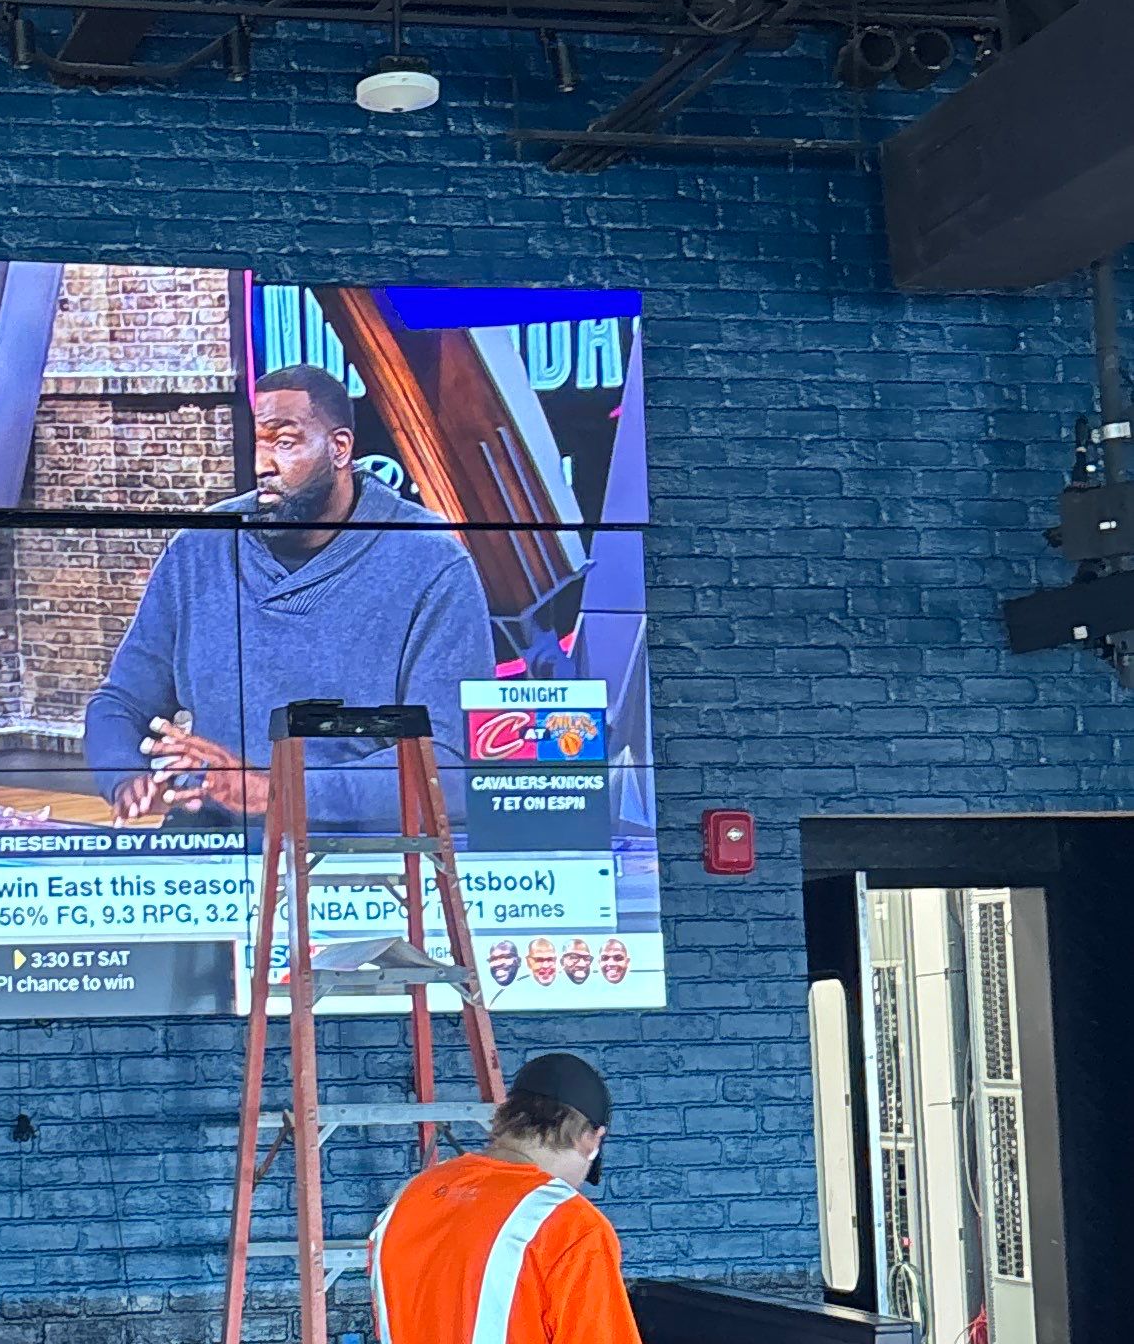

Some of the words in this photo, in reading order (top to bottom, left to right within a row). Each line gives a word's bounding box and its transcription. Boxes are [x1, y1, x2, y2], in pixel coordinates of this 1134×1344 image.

[499, 687, 568, 702] TONIGHT
[524, 729, 546, 740] AT
[471, 775, 605, 790] CAVALIERS-KNICKS
[492, 797, 501, 810] 7
[504, 797, 522, 810] ET
[524, 796, 545, 810] ON
[548, 796, 585, 809] ESPN
[116, 834, 146, 850] BY
[150, 834, 245, 850] HYUNDAI
[48, 876, 103, 897] East
[110, 875, 156, 896] this
[164, 878, 254, 896] season
[0, 906, 48, 927] 56%
[57, 905, 95, 928] FG,
[102, 905, 135, 924] 9.3
[143, 904, 198, 925] RPG,
[206, 903, 239, 922] 3.2
[311, 902, 359, 920] NBA
[494, 903, 565, 923] games
[30, 951, 69, 968] 3:30
[73, 951, 95, 967] ET
[98, 950, 130, 967] SAT
[17, 975, 80, 993] chance
[82, 974, 102, 991] to
[104, 974, 135, 991] win
